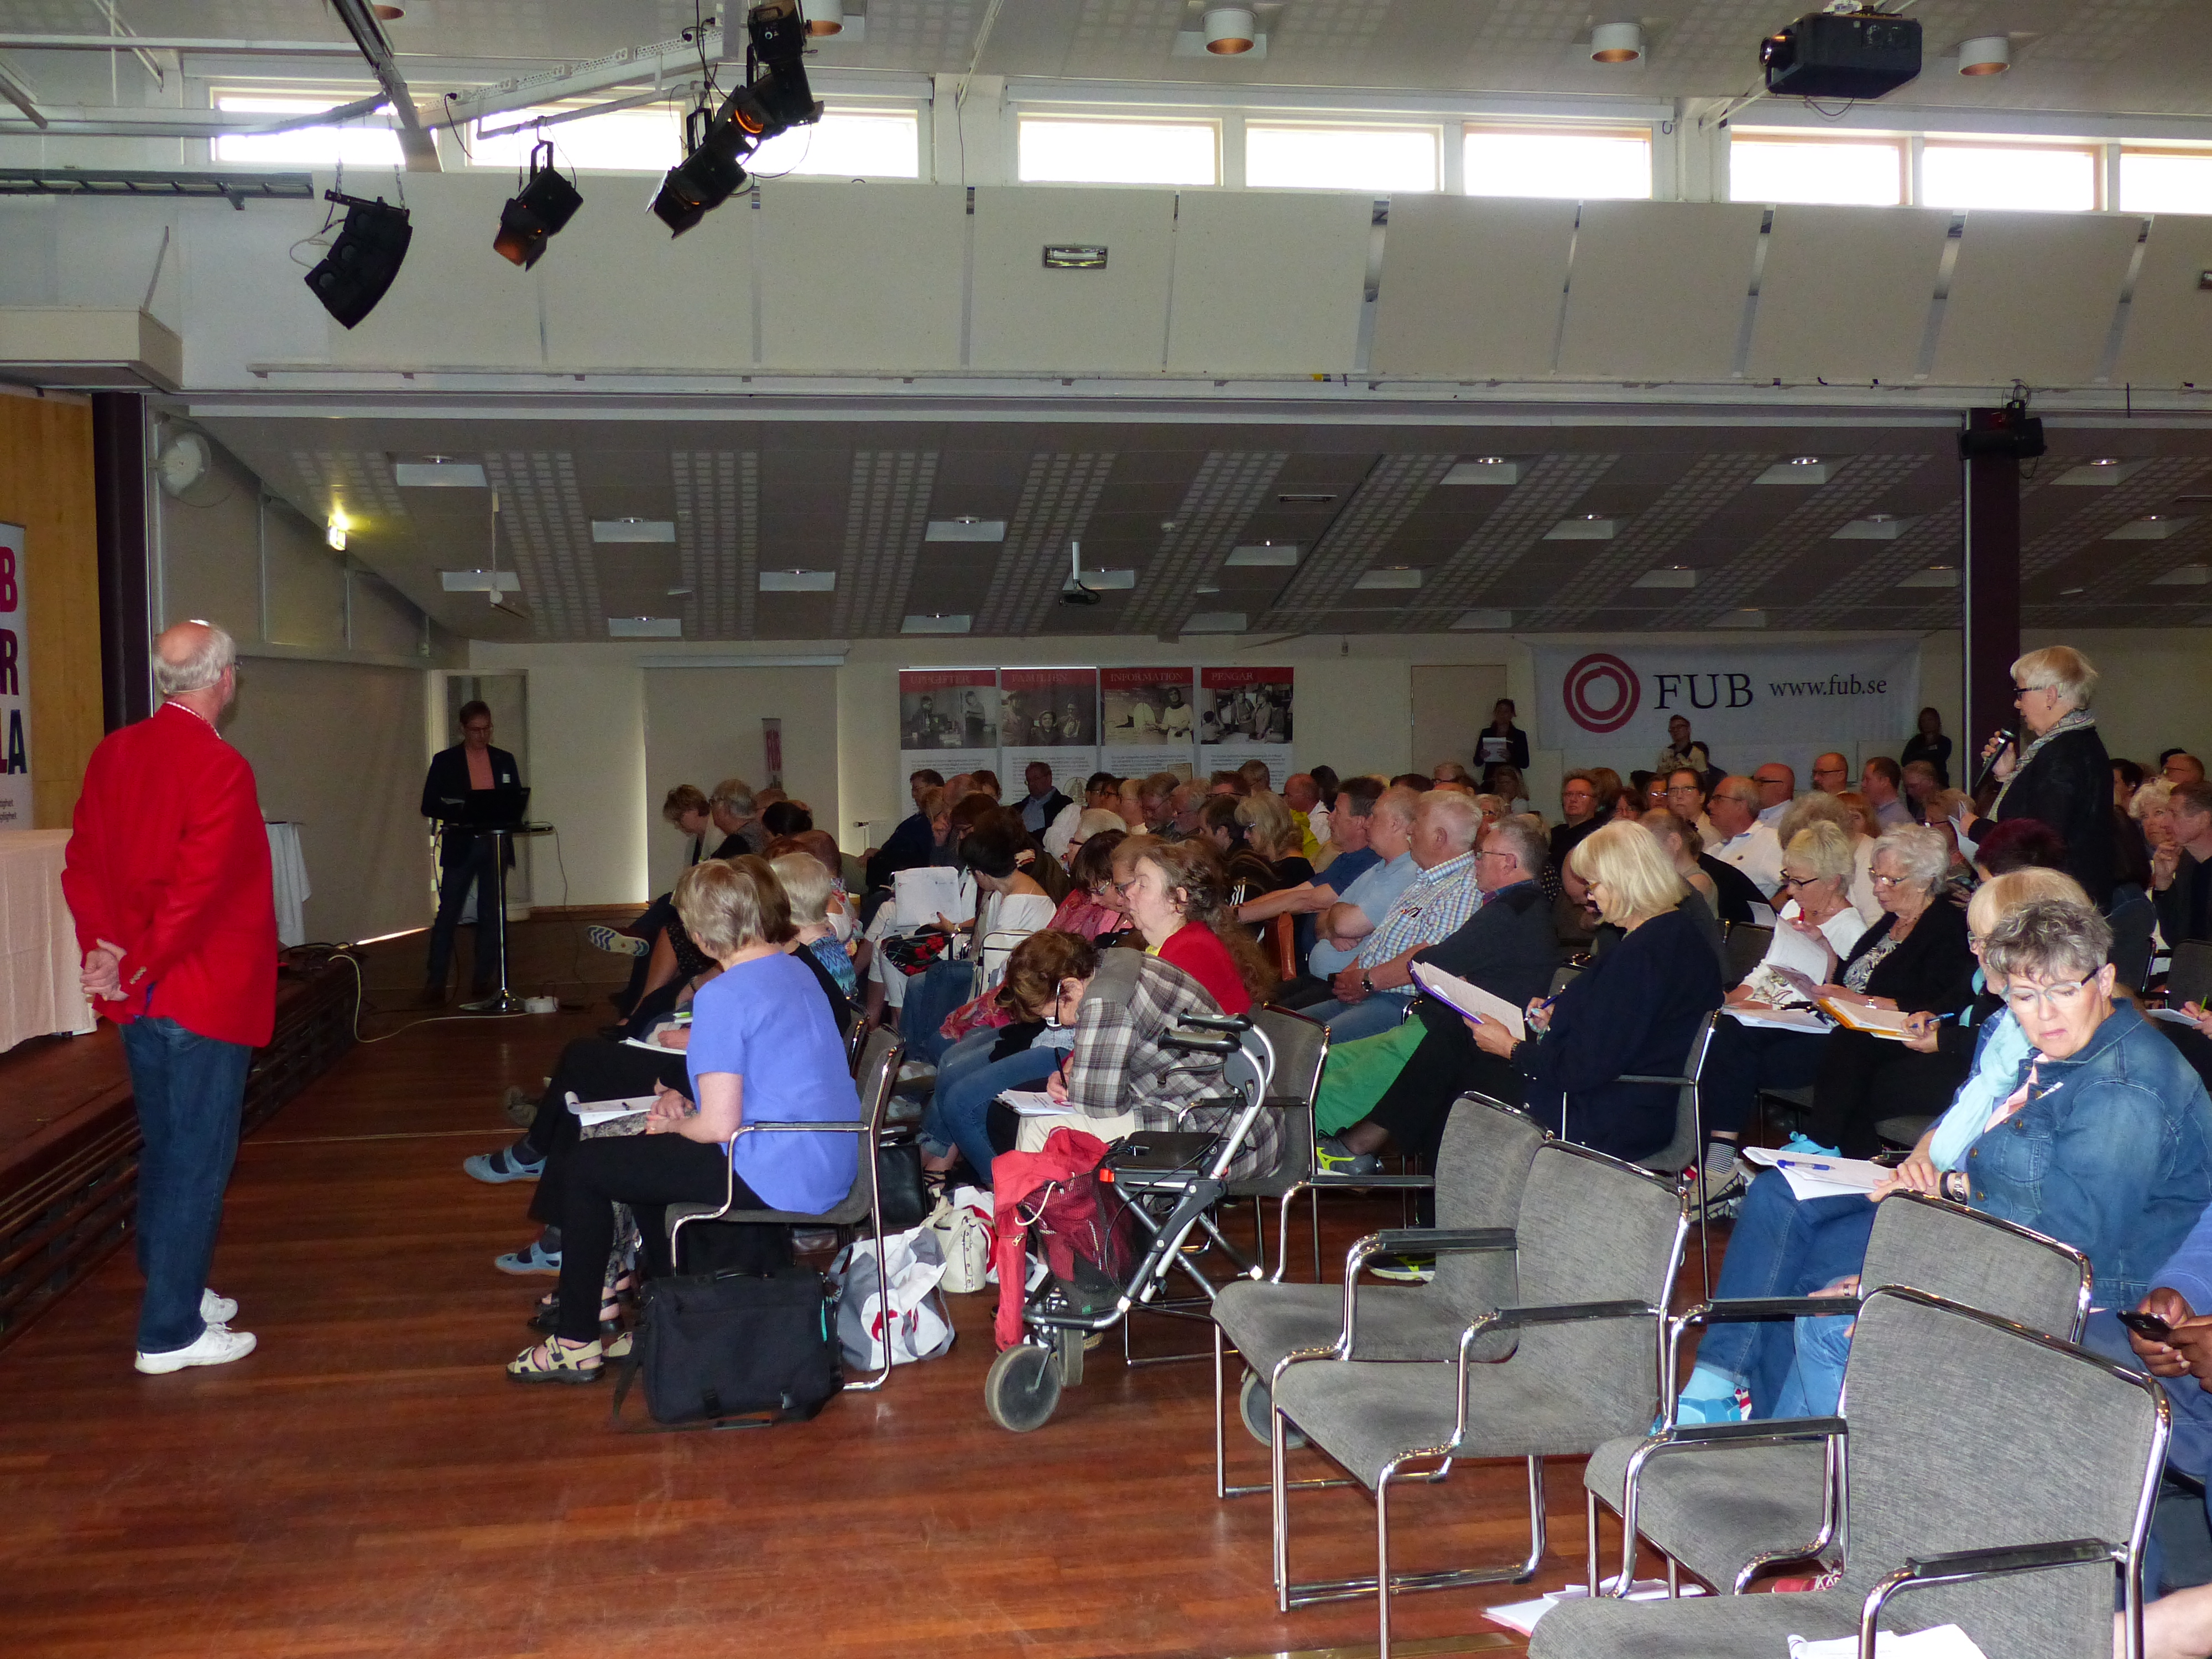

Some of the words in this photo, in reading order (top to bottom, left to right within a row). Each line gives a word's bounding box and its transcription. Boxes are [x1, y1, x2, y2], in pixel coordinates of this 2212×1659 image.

[1110, 672, 1183, 682] INFORMATION
[1211, 672, 1254, 681] PENGAR
[1653, 672, 1754, 709] FUB
[1768, 674, 1887, 696] www.fub.se
